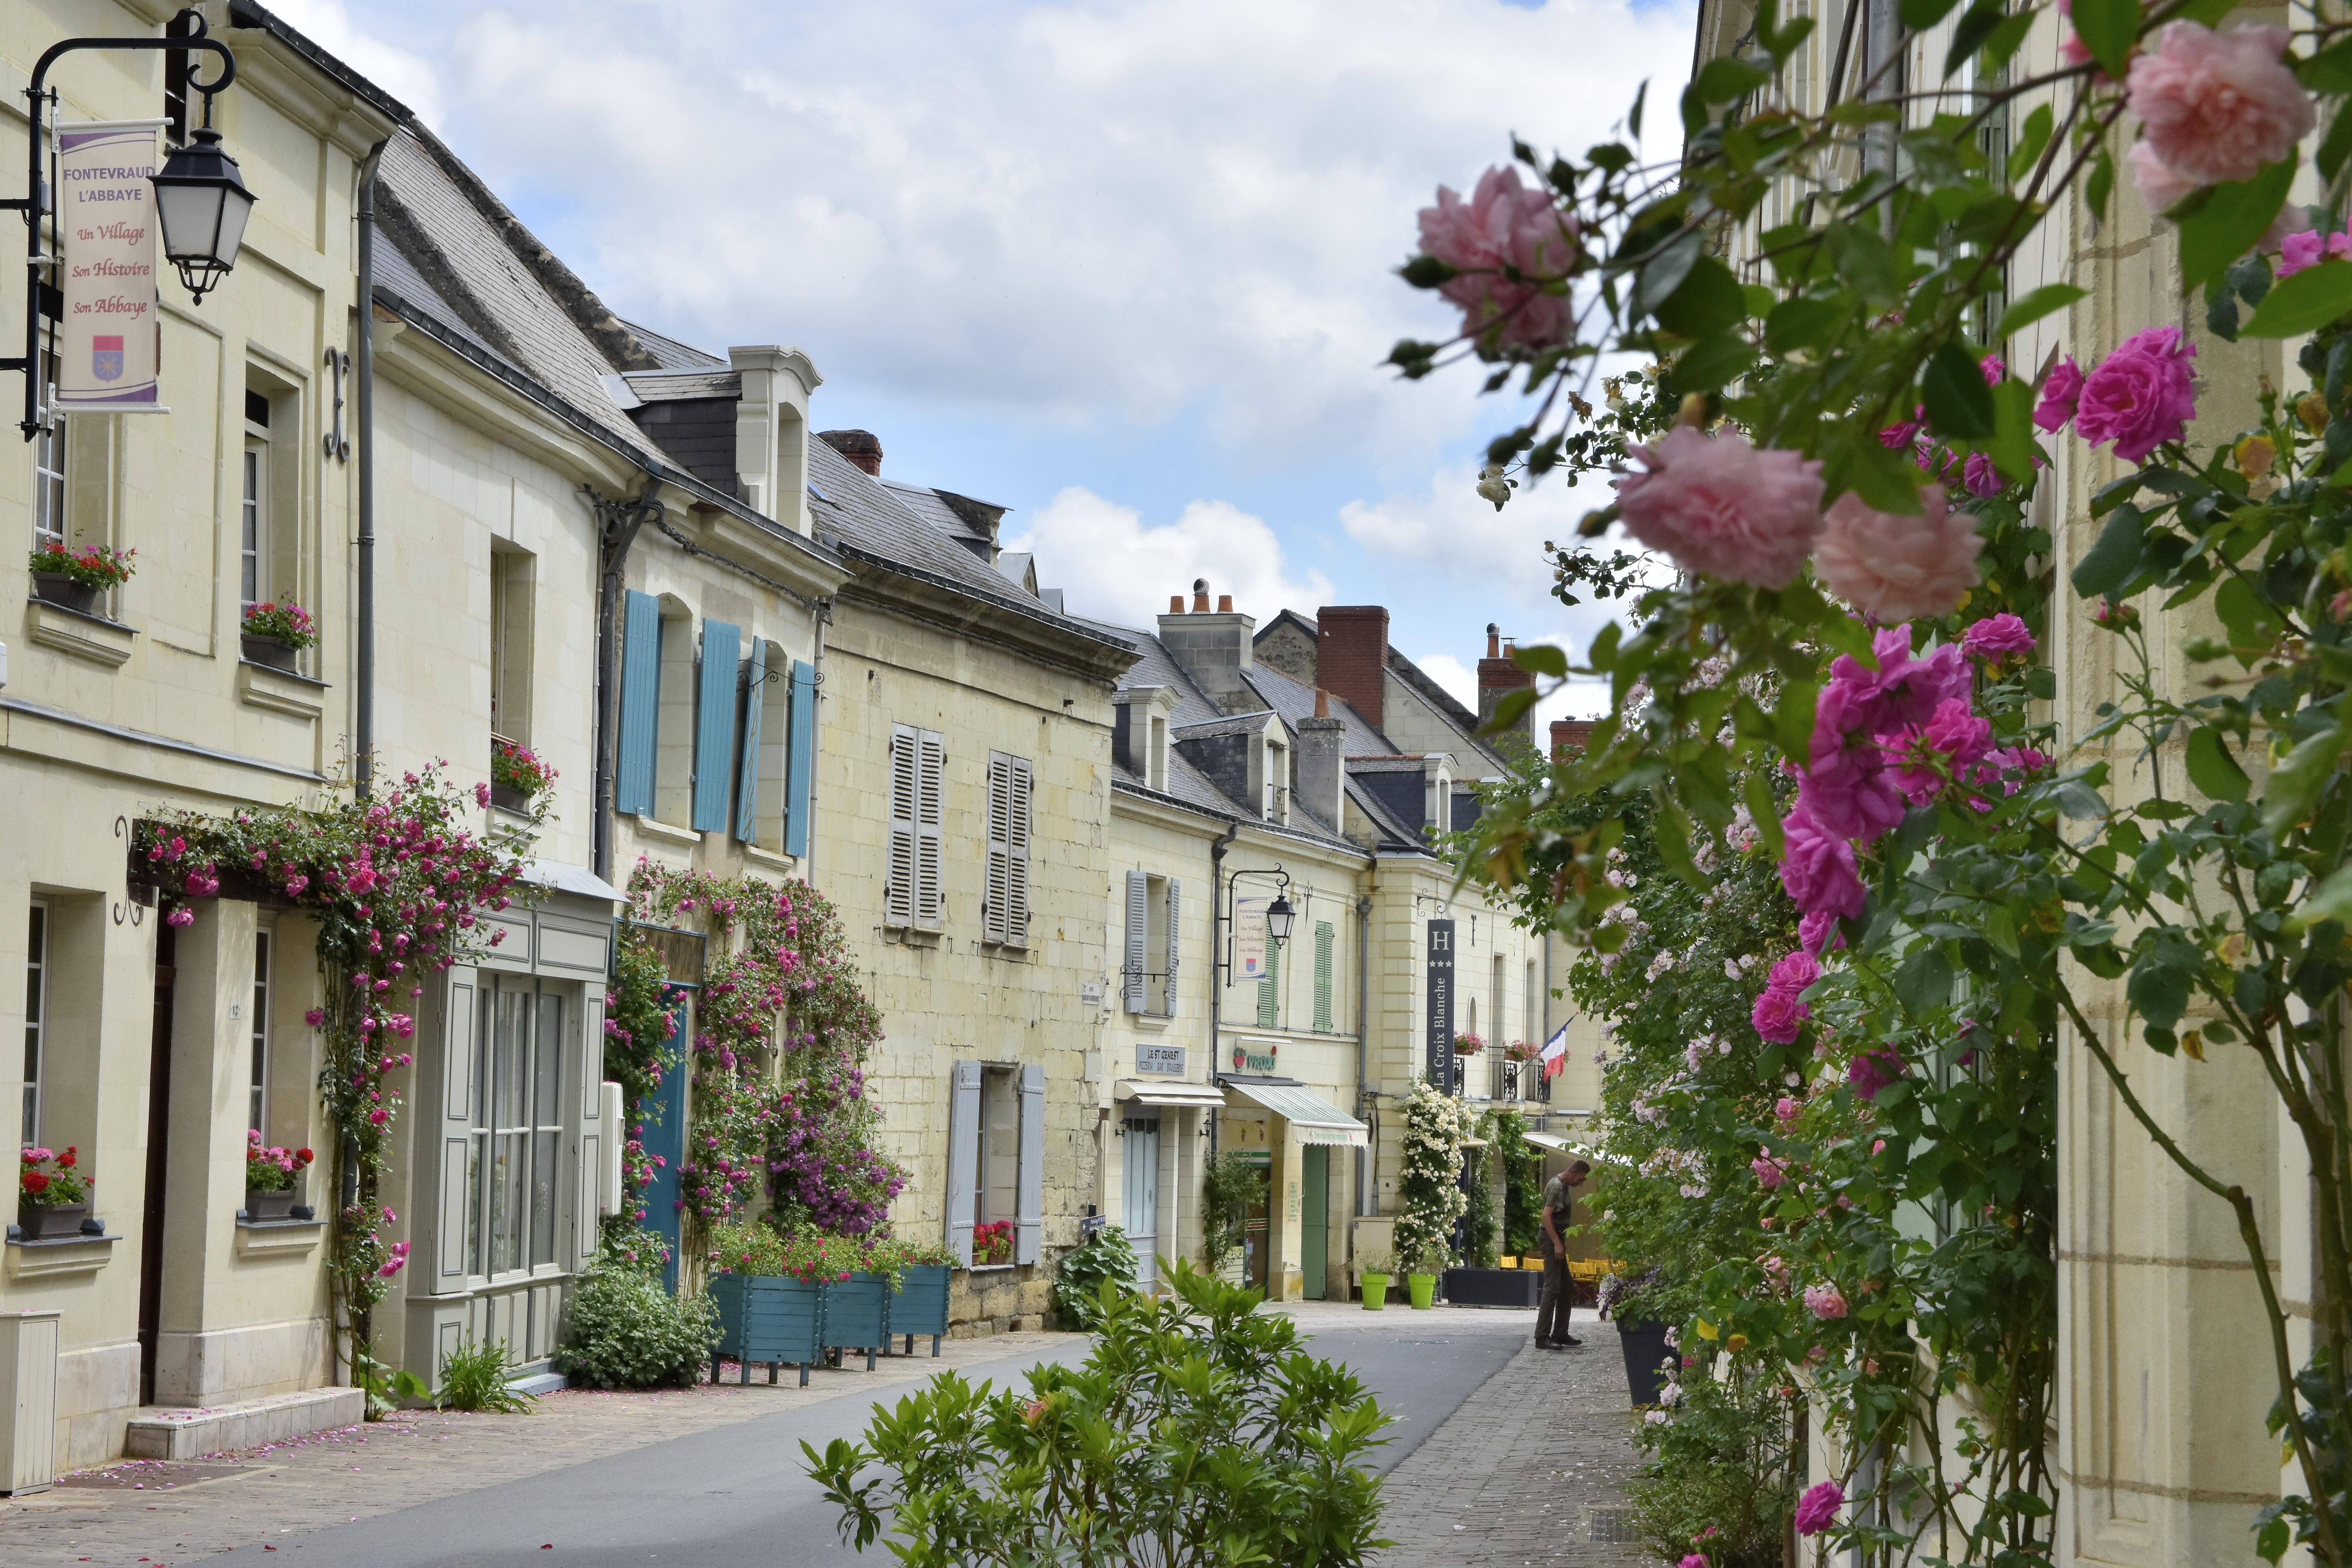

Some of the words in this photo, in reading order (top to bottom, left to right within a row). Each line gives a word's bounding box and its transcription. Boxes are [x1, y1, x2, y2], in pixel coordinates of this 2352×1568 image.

[64, 166, 155, 180] FONTEVRAUD
[79, 189, 142, 202] L'ABBAYE
[77, 229, 94, 240] Un
[97, 222, 144, 246] Village
[72, 266, 90, 277] Son
[93, 258, 149, 276] Histoire
[73, 302, 92, 314] Son
[95, 296, 147, 320] Abbaye
[1432, 931, 1450, 950] H
[1434, 978, 1445, 1028] Blanche
[1148, 1049, 1153, 1060] LE
[1155, 1050, 1160, 1060] ST
[1161, 1050, 1179, 1060] GENEST
[1434, 1033, 1445, 1067] Croix
[1139, 1061, 1152, 1071] PIZZERIA
[1167, 1063, 1183, 1073] BRASSERIE
[1434, 1072, 1445, 1087] La
